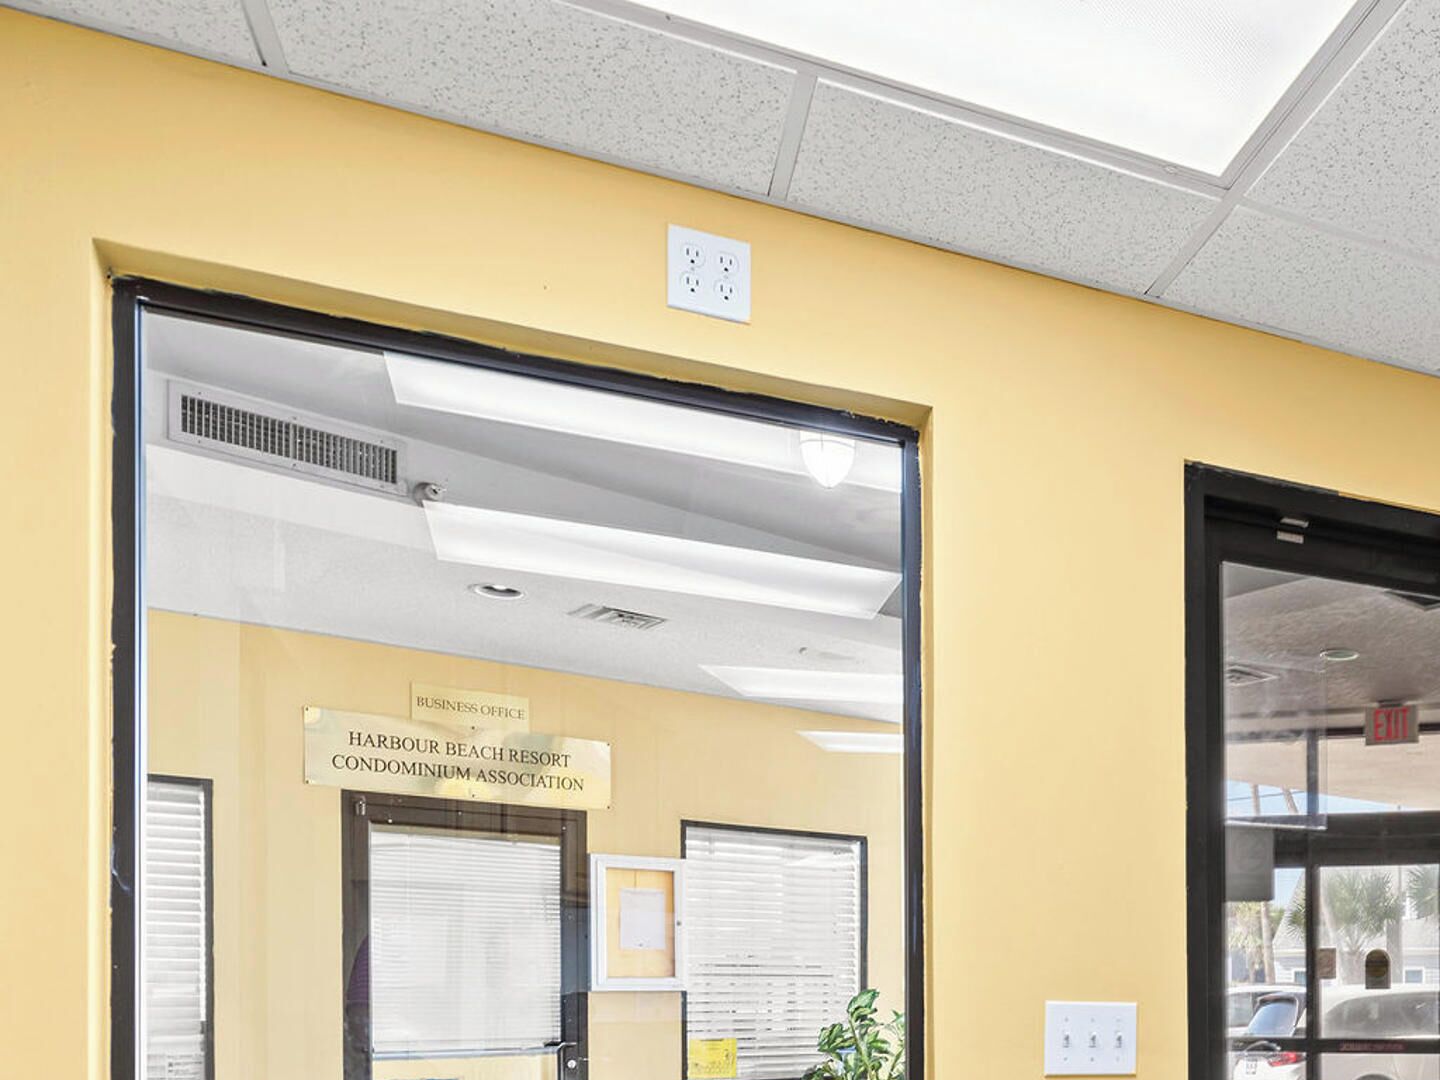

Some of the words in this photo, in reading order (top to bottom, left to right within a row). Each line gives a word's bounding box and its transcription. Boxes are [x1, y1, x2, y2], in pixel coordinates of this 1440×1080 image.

[416, 696, 478, 714] BUSINESS
[480, 704, 526, 720] OFFICE
[1374, 708, 1408, 741] EXIT
[349, 731, 440, 755] HARBOUR
[446, 742, 504, 762] BEACH
[509, 749, 571, 768] RESORT
[331, 754, 471, 781] CONDOMINIUM
[476, 769, 584, 792] ASSOCIATION
